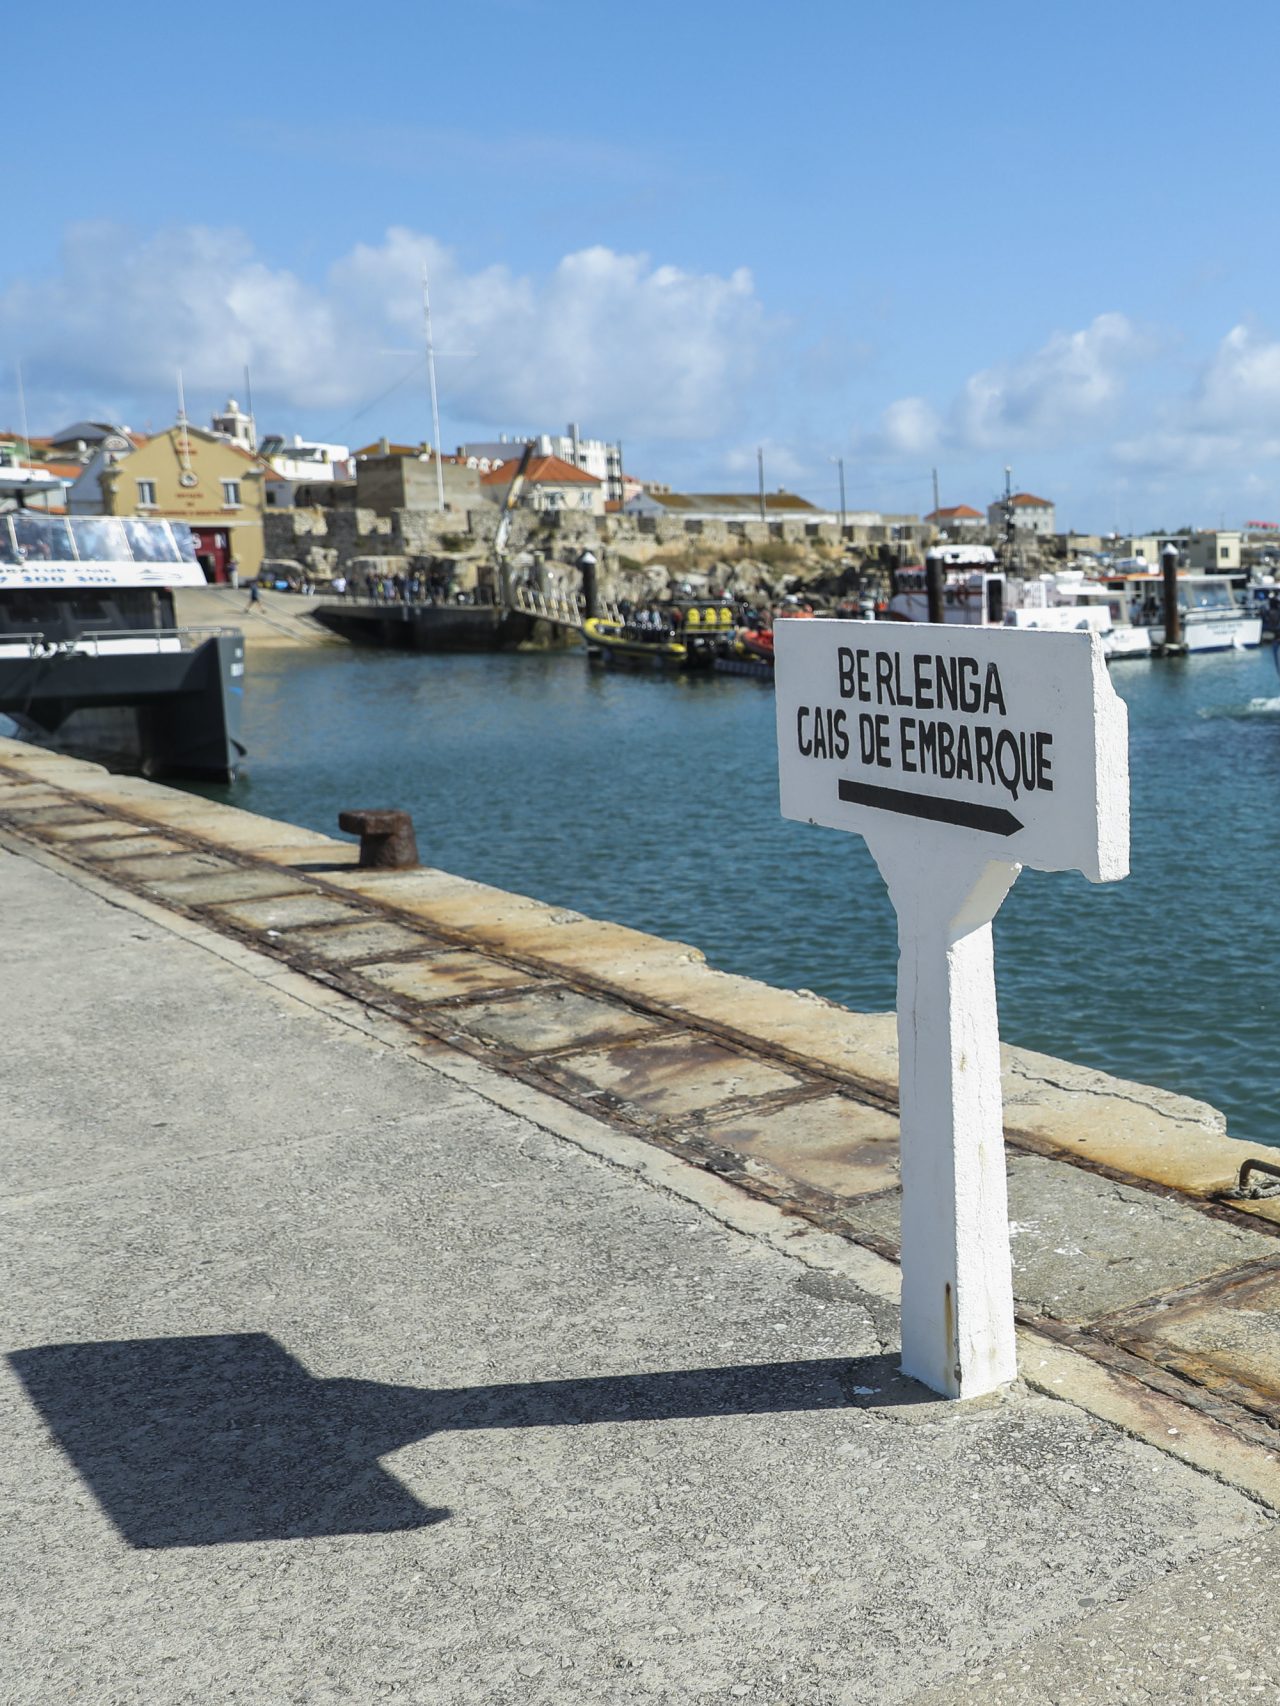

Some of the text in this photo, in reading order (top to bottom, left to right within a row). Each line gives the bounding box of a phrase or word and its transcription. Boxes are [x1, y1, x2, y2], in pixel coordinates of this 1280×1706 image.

[837, 647, 1007, 716] BERLENGA
[797, 706, 1054, 801] CAIS DE EMBARQUE
